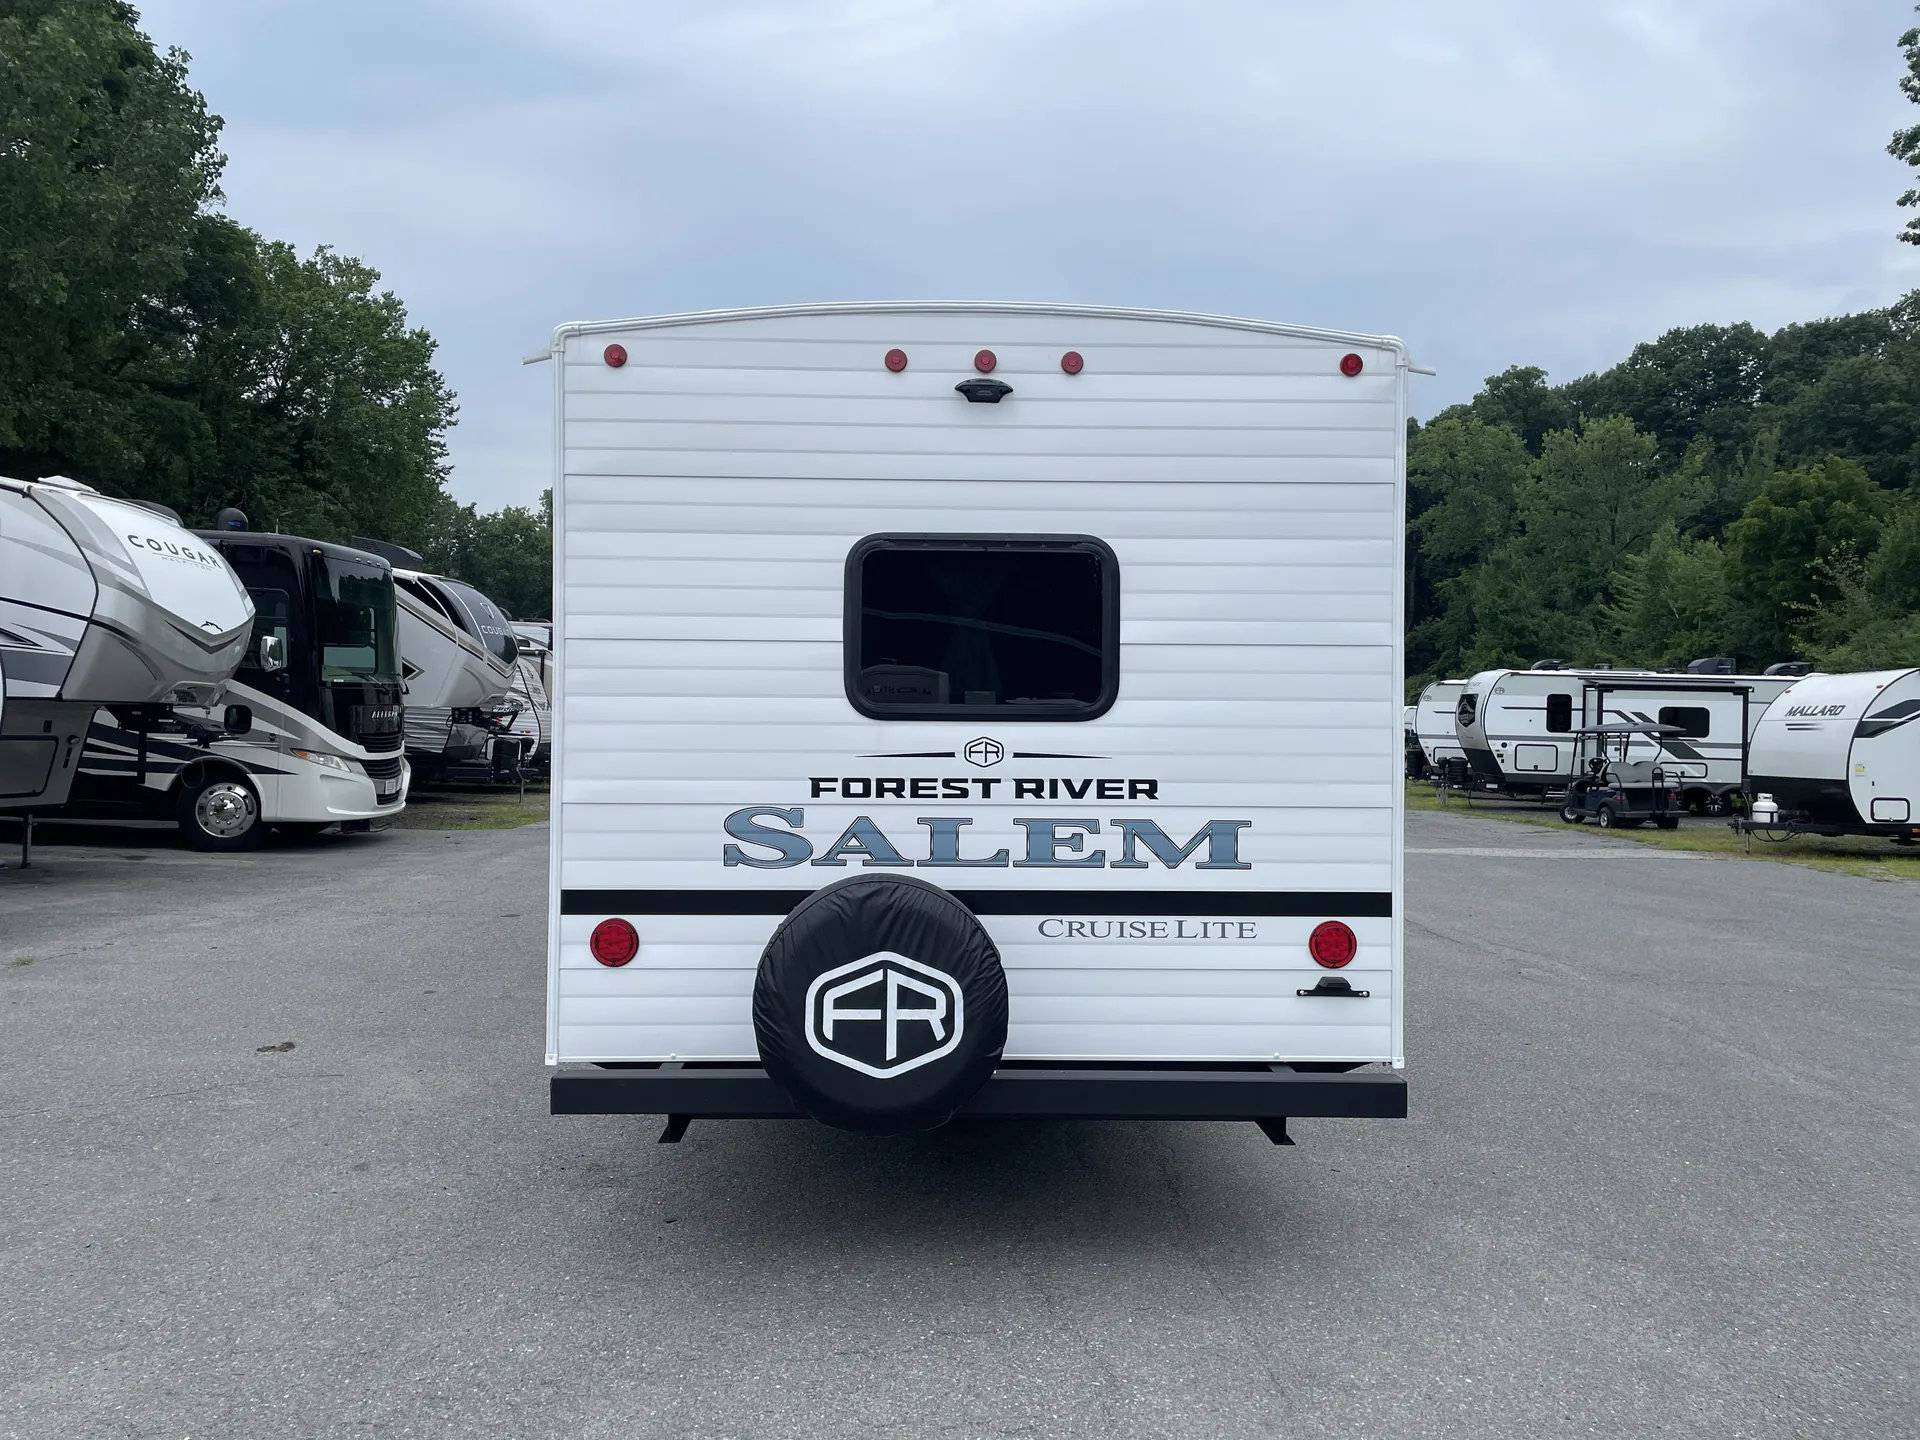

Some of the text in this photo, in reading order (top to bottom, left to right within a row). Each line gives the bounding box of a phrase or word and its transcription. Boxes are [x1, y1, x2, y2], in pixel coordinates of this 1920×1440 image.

[127, 534, 221, 569] COUGAR
[1785, 705, 1846, 717] MALLARD
[967, 740, 1001, 764] FR
[808, 777, 1160, 800] FOREST RIVER
[723, 807, 1253, 870] SALEM
[822, 968, 947, 1061] FR
